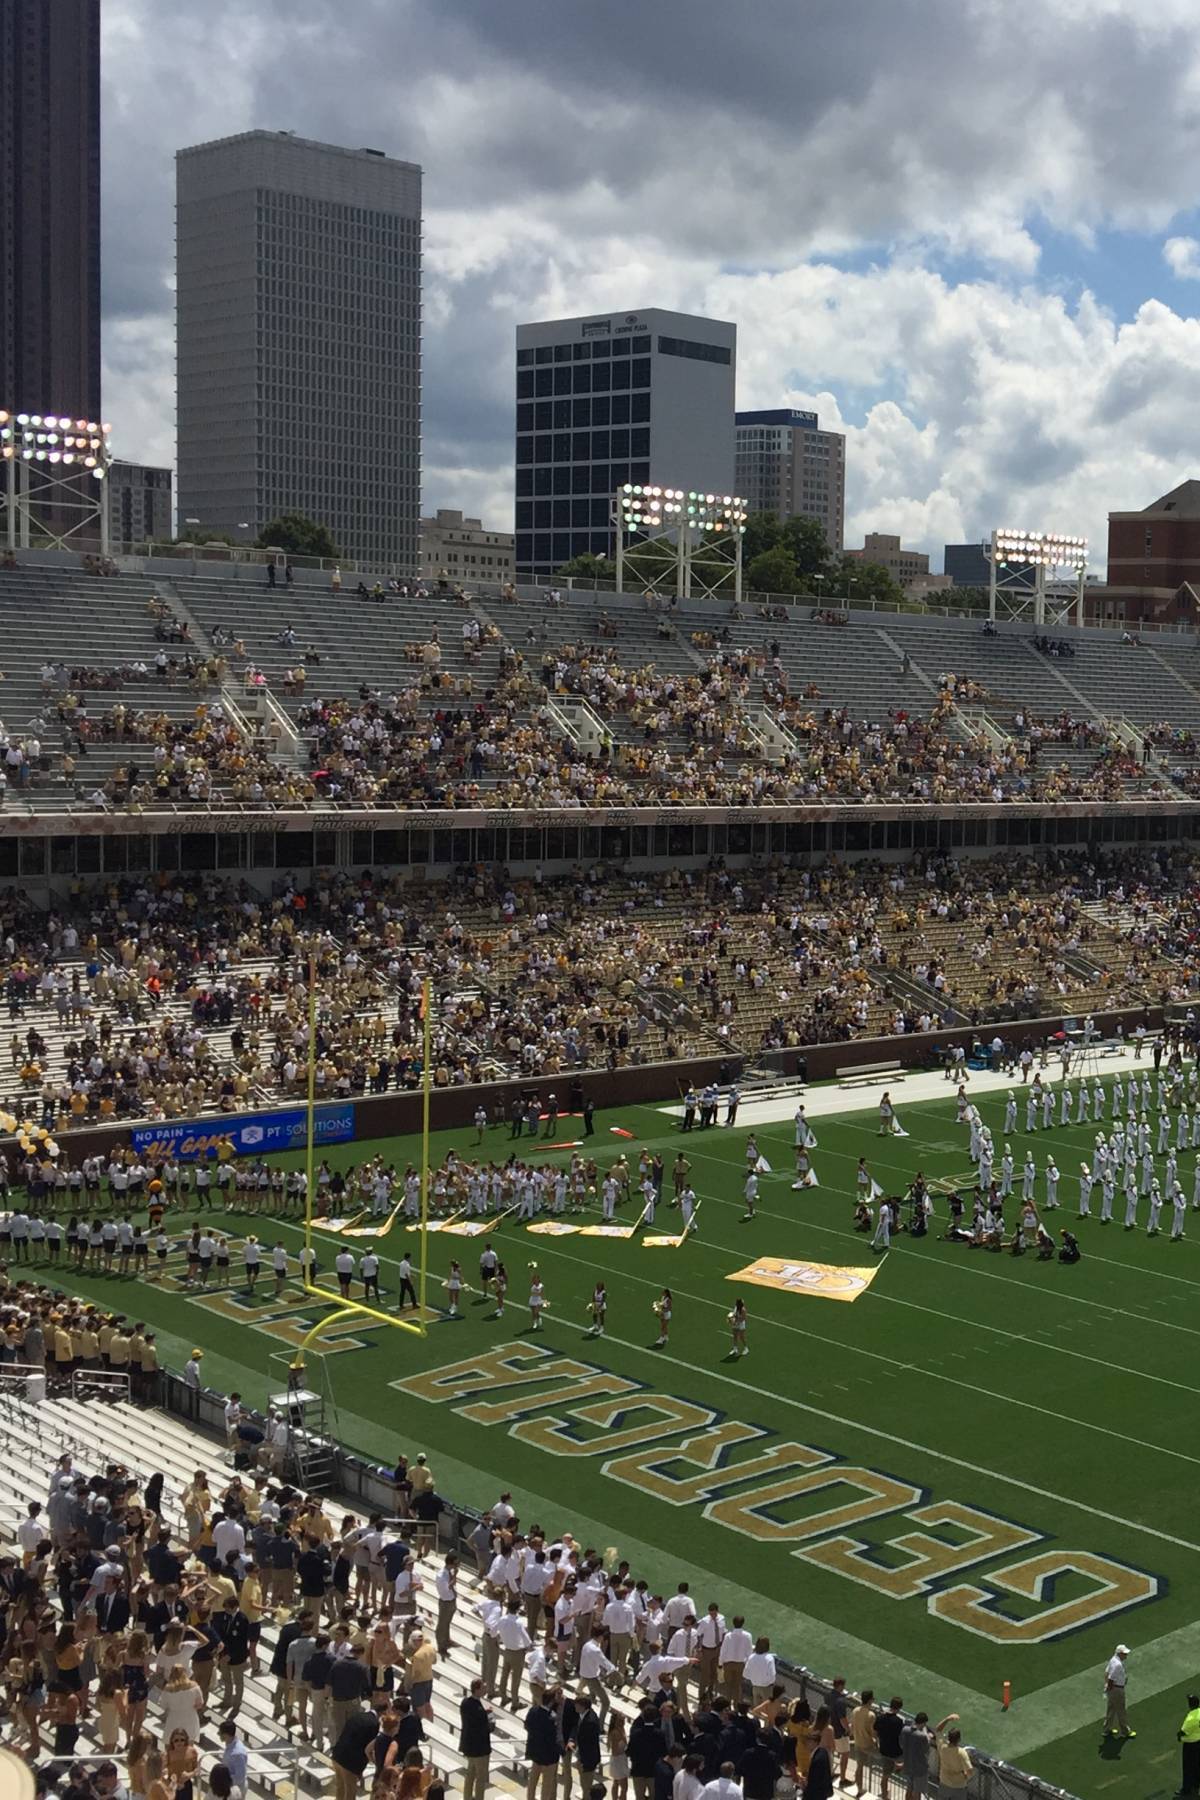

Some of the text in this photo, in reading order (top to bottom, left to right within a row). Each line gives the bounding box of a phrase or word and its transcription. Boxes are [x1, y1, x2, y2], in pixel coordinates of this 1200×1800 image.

[135, 1131, 152, 1142] NO
[156, 1128, 184, 1140] PAIN
[266, 1127, 281, 1139] PT
[143, 1139, 176, 1156] ALL
[387, 1339, 1162, 1646] GEORGIA
